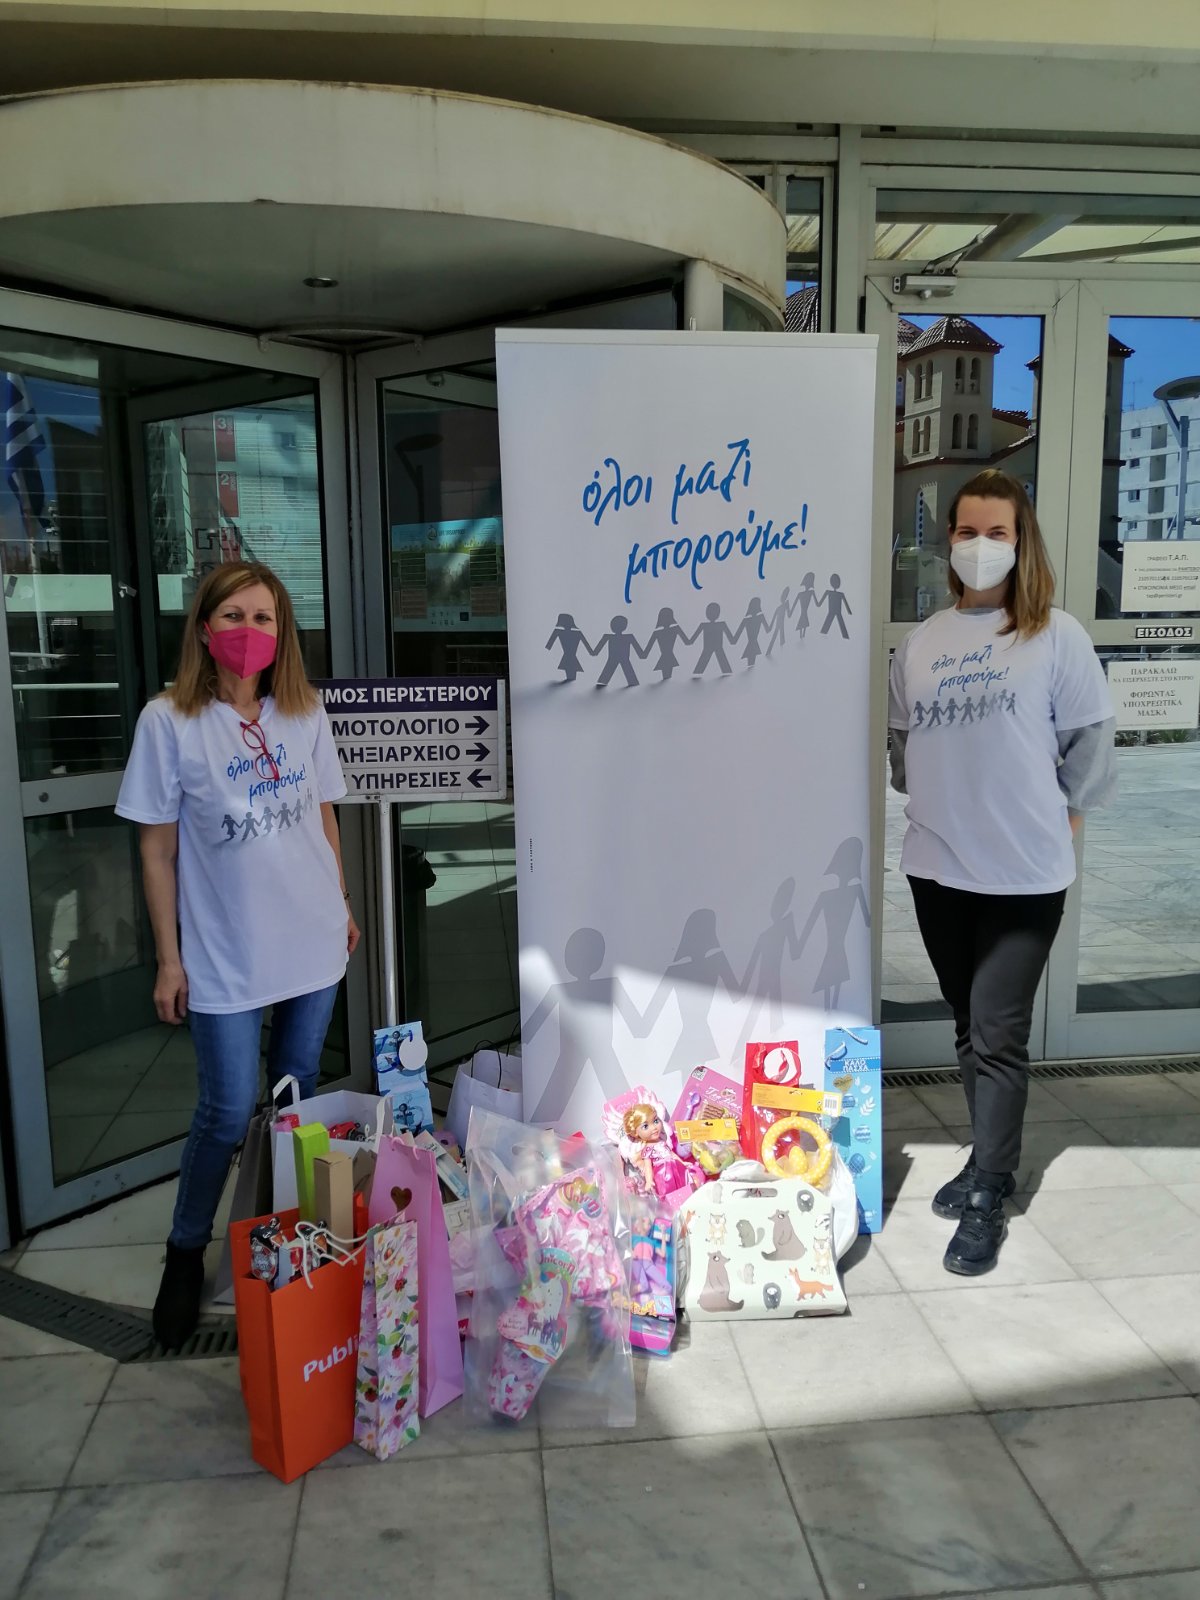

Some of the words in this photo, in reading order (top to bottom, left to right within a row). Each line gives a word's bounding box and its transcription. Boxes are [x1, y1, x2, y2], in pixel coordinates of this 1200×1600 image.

[583, 458, 653, 526] όλοι
[671, 438, 752, 525] μαζί
[624, 503, 809, 604] μπορούμε!
[1136, 627, 1192, 638] ΕΙΣΟΔΟΣ
[1131, 667, 1177, 676] ΠΑΡΑΚΑΛΩ
[373, 685, 493, 704] ΠΕΡΙΣΤΕΡΙΟΥ
[1130, 690, 1176, 698] ΦΟΡΩΝΤΑΣ
[1123, 700, 1183, 708] ΥΠΟΧΡΕΩΤΙΚΑ
[1137, 709, 1167, 717] ΜΑΣΚΑ
[331, 718, 460, 737] ΜΟΤΟΛΟΓΙΟ
[337, 744, 461, 764] ΛΗΞΙΑΡΧΕΙΟ
[351, 771, 462, 790] ΥΠΗΡΕΣΙΕΣ
[844, 1059, 867, 1067] ΚΑΛΟ
[303, 1334, 359, 1383] Publi
